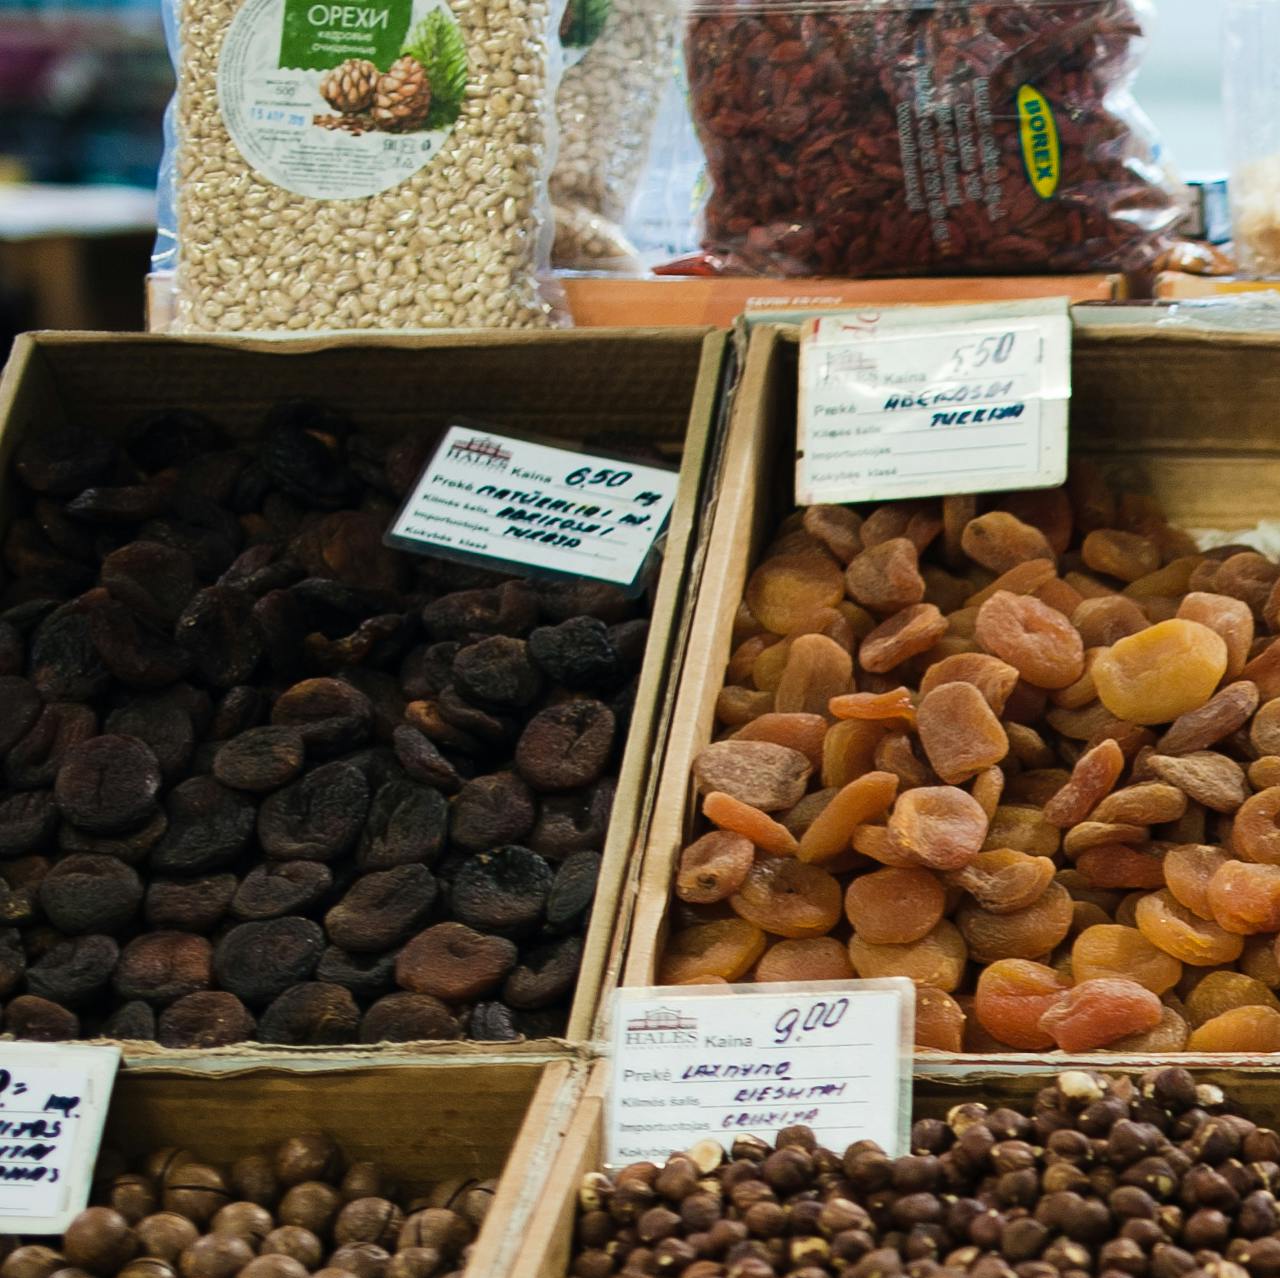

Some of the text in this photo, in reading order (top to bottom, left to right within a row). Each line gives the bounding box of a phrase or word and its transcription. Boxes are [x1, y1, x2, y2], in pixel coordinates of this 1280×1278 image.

[307, 5, 389, 29] ОРЕХИ
[1025, 102, 1054, 179] BOREX
[705, 1034, 753, 1048] Kaina
[623, 1068, 672, 1083] Prekė
[621, 1096, 667, 1109] Kilmės
